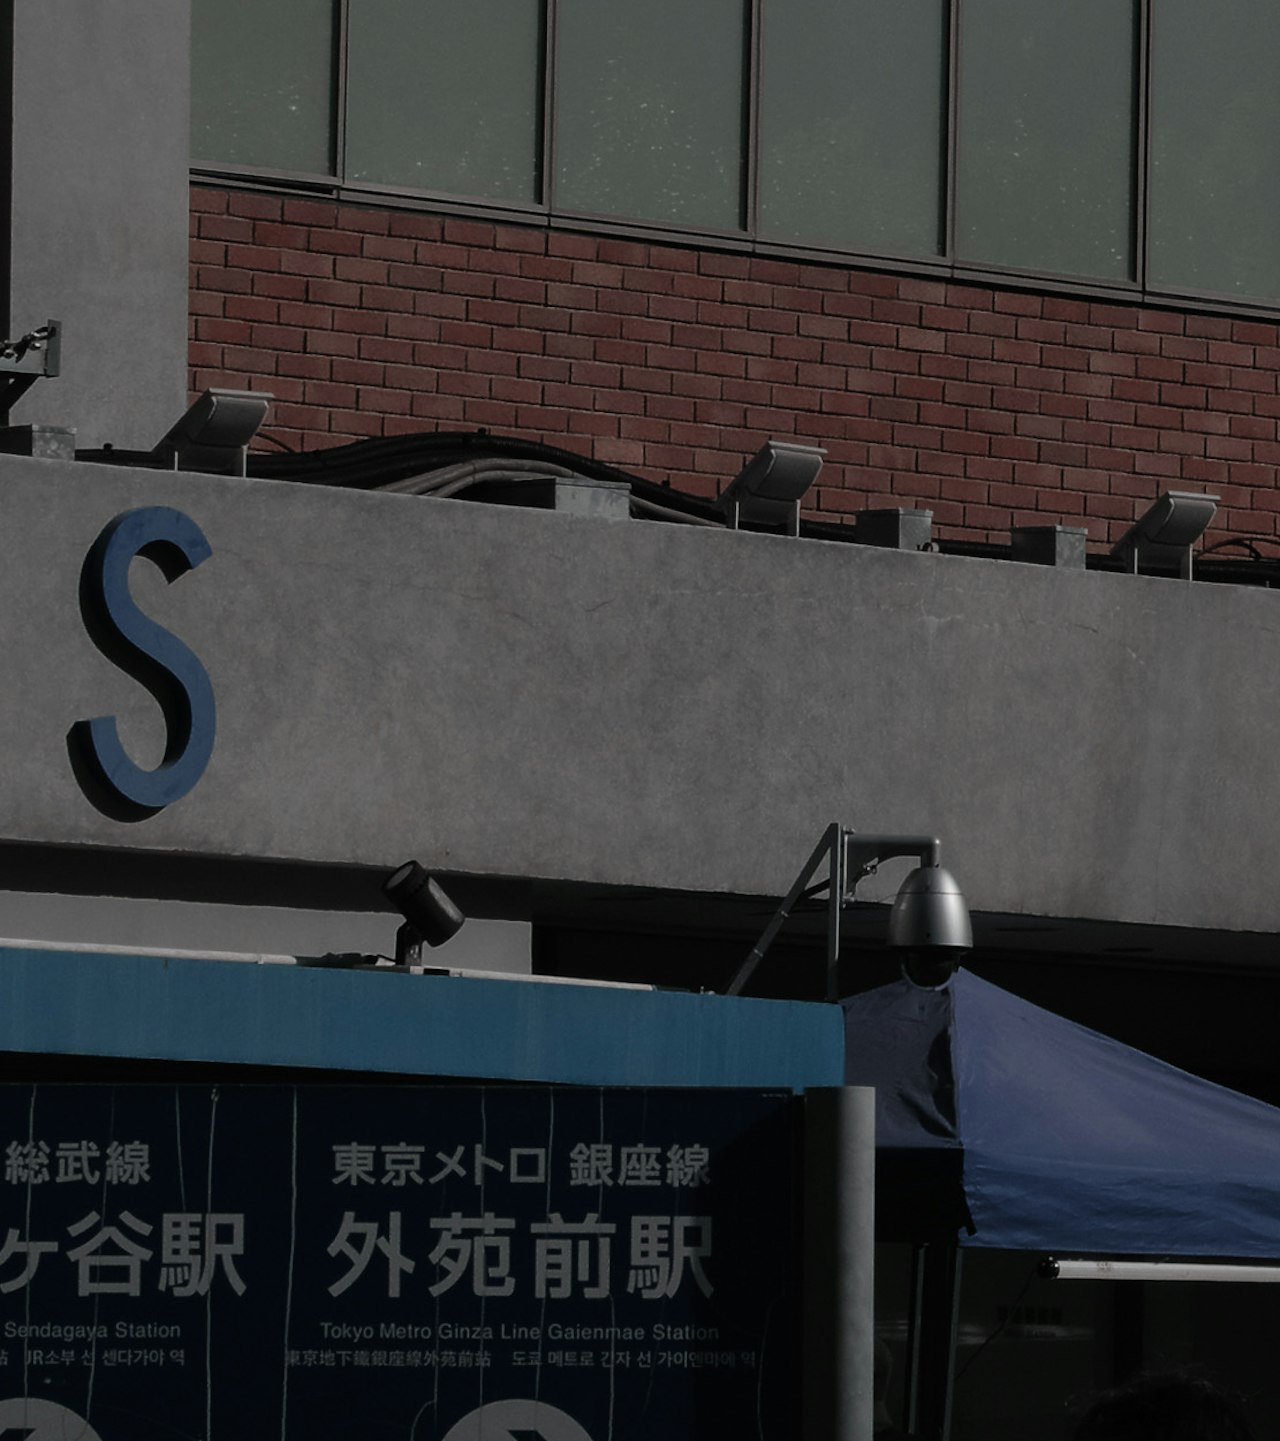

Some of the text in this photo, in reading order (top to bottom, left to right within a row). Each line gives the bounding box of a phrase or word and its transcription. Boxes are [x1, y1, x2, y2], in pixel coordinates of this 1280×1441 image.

[74, 506, 216, 815] S
[4, 1140, 151, 1185] 総武線
[332, 1141, 712, 1187] 東京メトロ 銀座線
[326, 1210, 714, 1300] 外苑前駅
[4, 1321, 181, 1342] Sendagaya Station
[320, 1322, 720, 1342] Tokyo Metro Ginza Line Gaienmae Station
[170, 1349, 185, 1366] 역
[547, 1350, 594, 1368] 메트로
